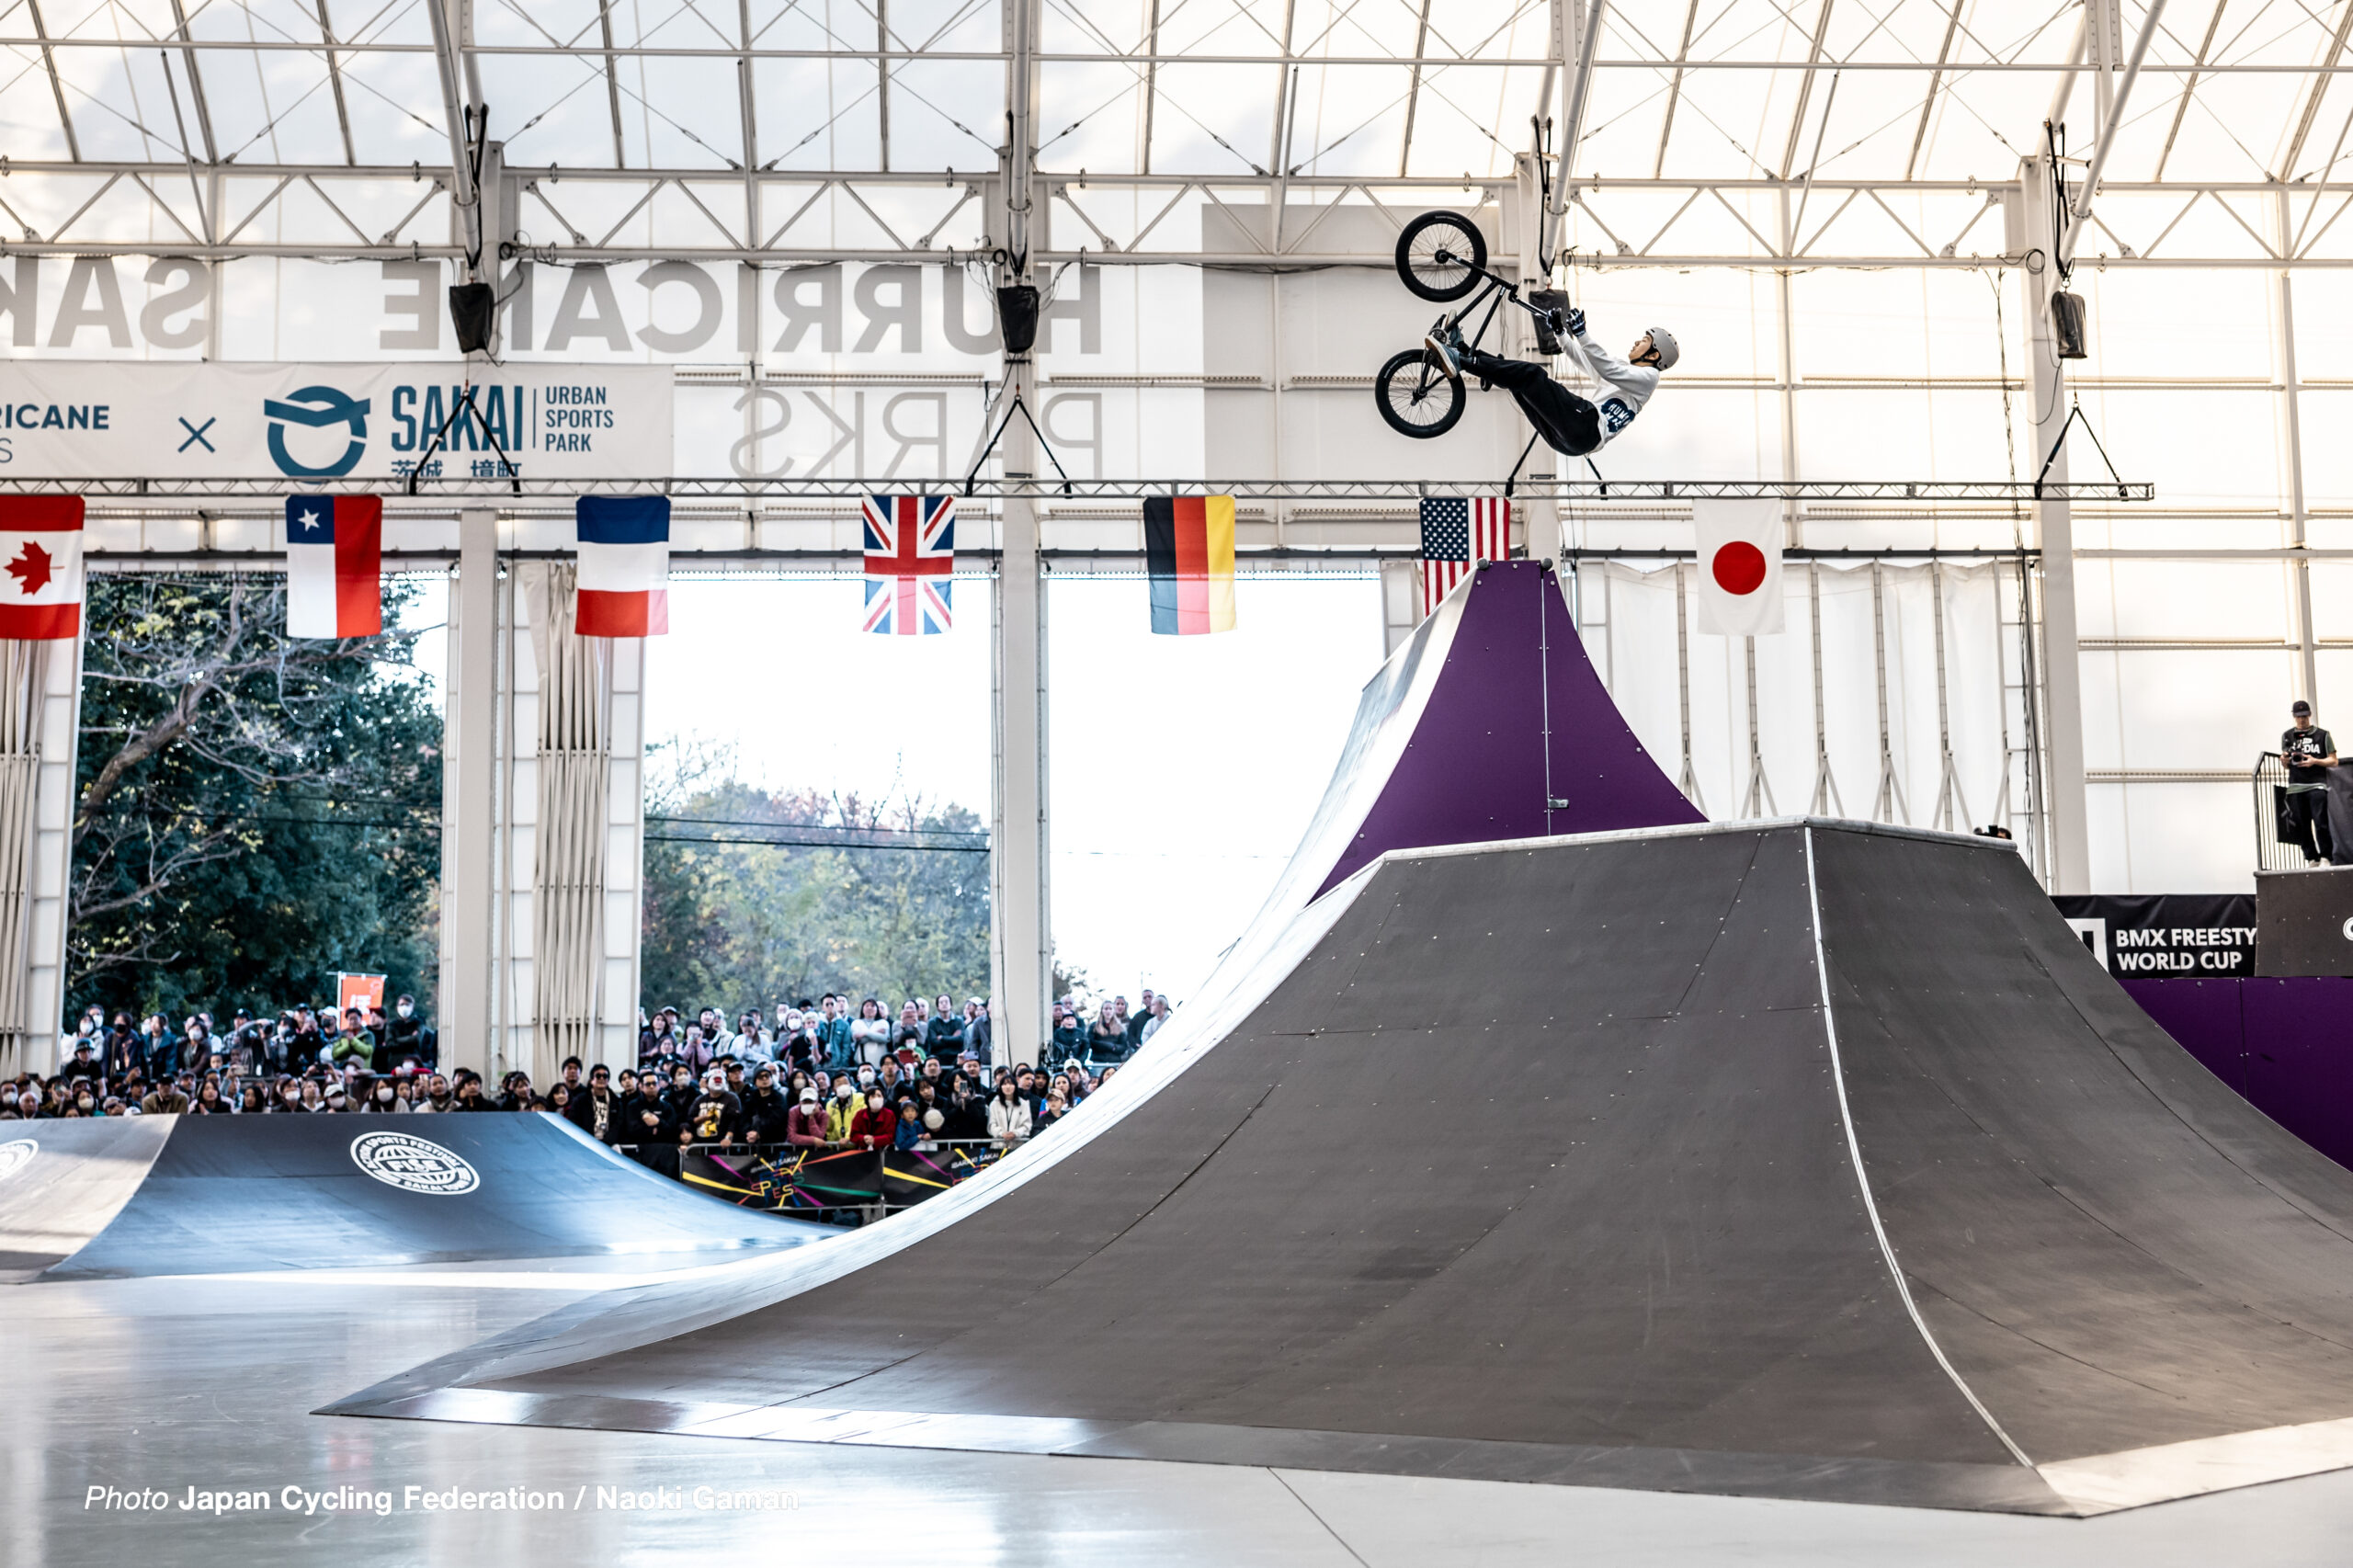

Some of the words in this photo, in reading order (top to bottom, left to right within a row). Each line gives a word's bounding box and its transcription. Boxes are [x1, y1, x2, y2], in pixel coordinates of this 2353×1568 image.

[546, 386, 606, 404] URBAN
[0, 403, 109, 429] ICANE
[392, 385, 523, 451] SAKAI
[546, 410, 613, 427] SPORTS
[546, 434, 591, 451] PARK
[2116, 928, 2166, 948] BMX
[2171, 927, 2257, 947] FREESTY
[2117, 952, 2195, 971] WORLD
[2200, 951, 2243, 970] CUP
[387, 1159, 443, 1172] FISE
